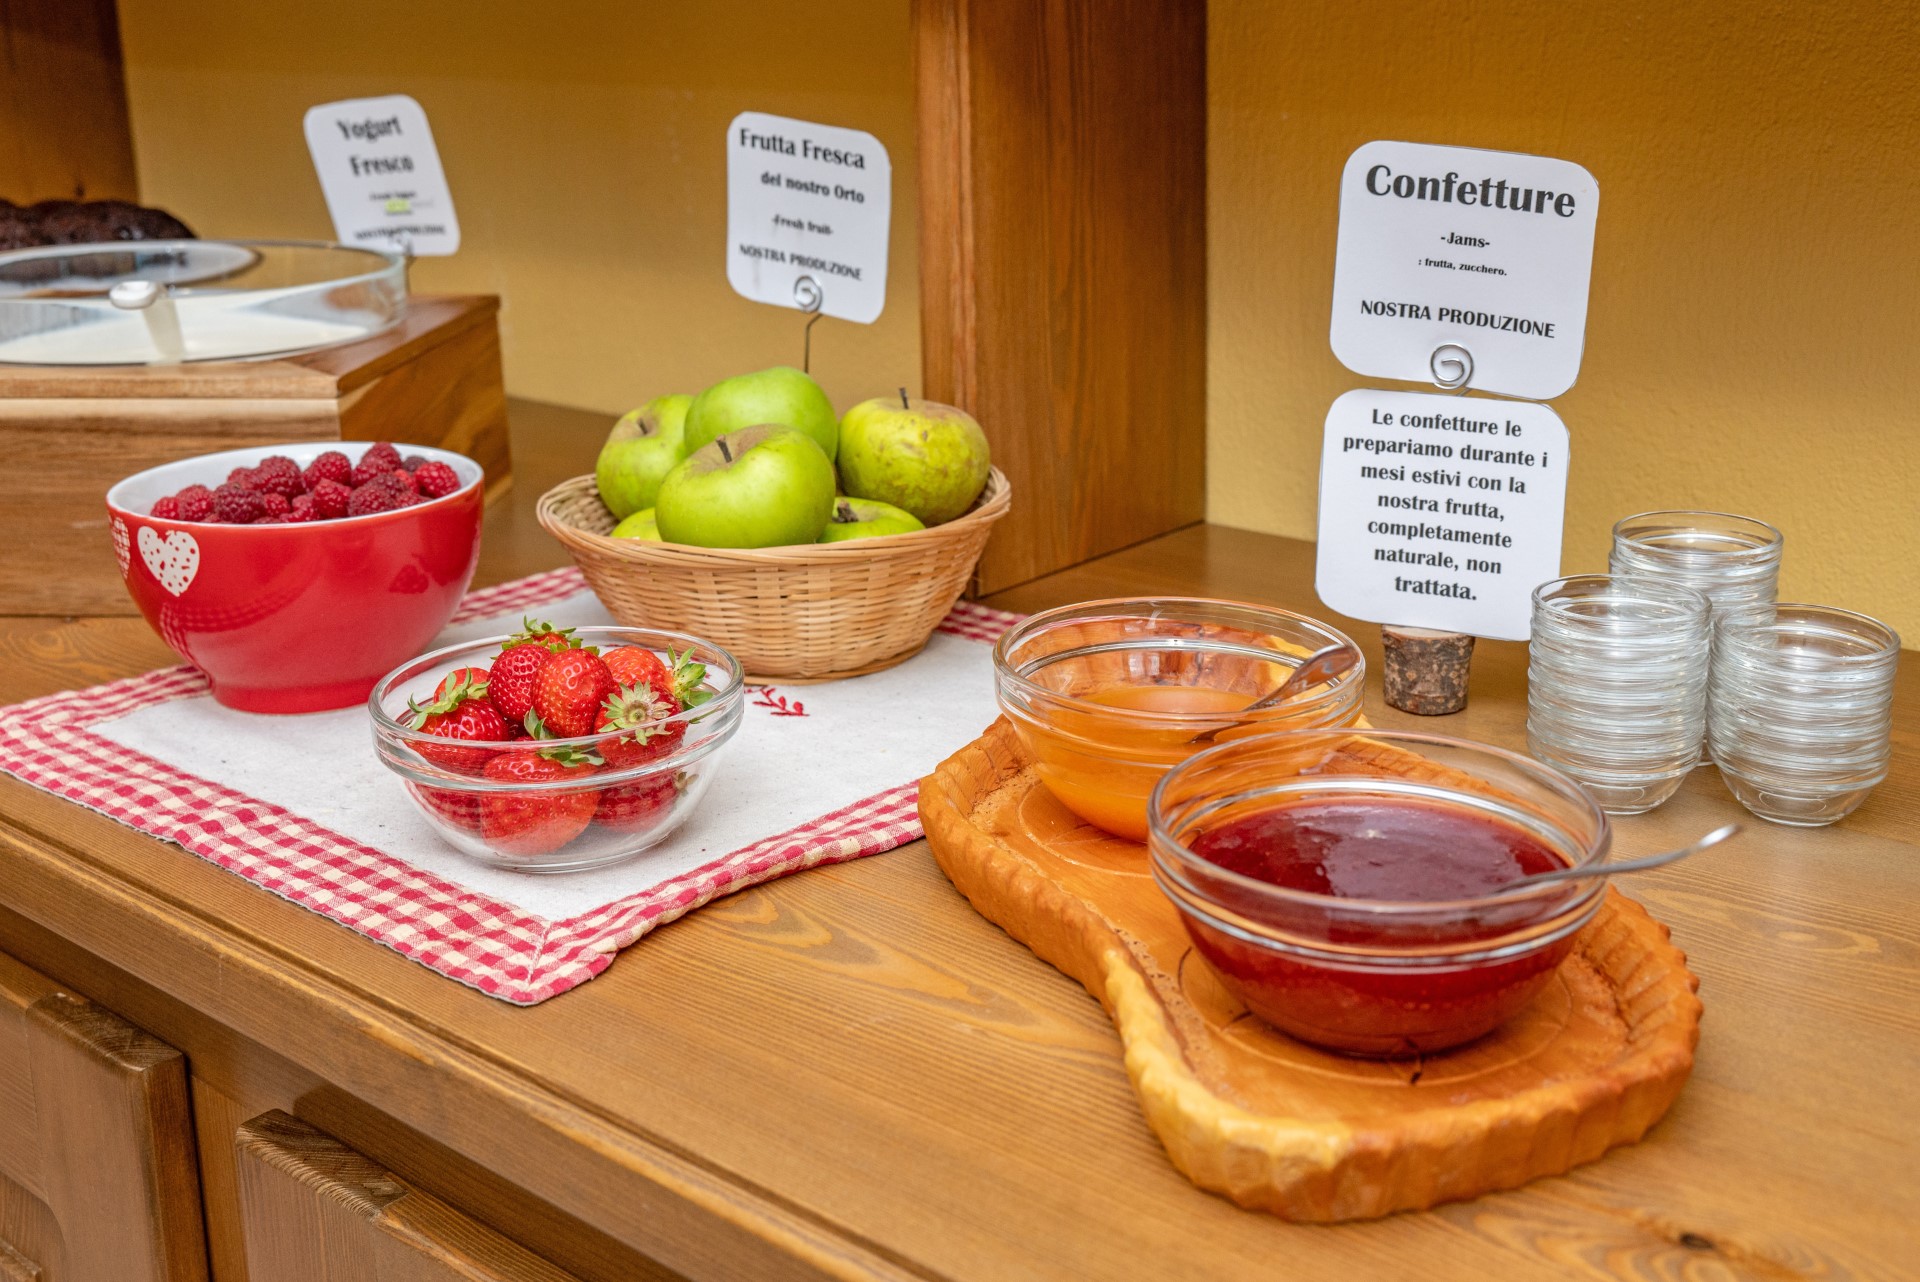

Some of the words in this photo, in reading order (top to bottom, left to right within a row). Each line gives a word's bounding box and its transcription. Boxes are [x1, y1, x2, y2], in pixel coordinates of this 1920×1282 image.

[337, 116, 402, 142] Yogurt
[741, 129, 795, 155] Frutta
[803, 140, 864, 169] Fresca
[350, 157, 413, 175] Fresco
[761, 172, 781, 186] del
[786, 178, 830, 196] nostro
[834, 185, 864, 203] Orto
[1366, 164, 1576, 217] Confetture
[1441, 232, 1490, 247] -Jams-
[739, 244, 785, 263] NOSTRA
[790, 253, 862, 281] PRODUZIONE
[1425, 258, 1455, 270] frutta,
[1459, 264, 1507, 275] zucchero.
[1361, 300, 1431, 320] NOSTRA
[1439, 308, 1555, 338] PRODUZIONE
[1373, 409, 1393, 425] Le
[1400, 414, 1498, 435] confetture
[1506, 421, 1521, 437] le
[1344, 438, 1453, 457] prepariamo
[1460, 445, 1534, 466] durante
[1542, 452, 1548, 468] i
[1361, 466, 1404, 481] mesi
[1412, 470, 1460, 486] estivi
[1468, 477, 1501, 491] con
[1509, 477, 1525, 493] la
[1378, 496, 1438, 512] nostra
[1446, 498, 1504, 521] frutta,
[1368, 521, 1511, 548] completamente
[1375, 549, 1458, 571] naturale,
[1467, 559, 1501, 574] non
[1395, 577, 1476, 600] trattata.
